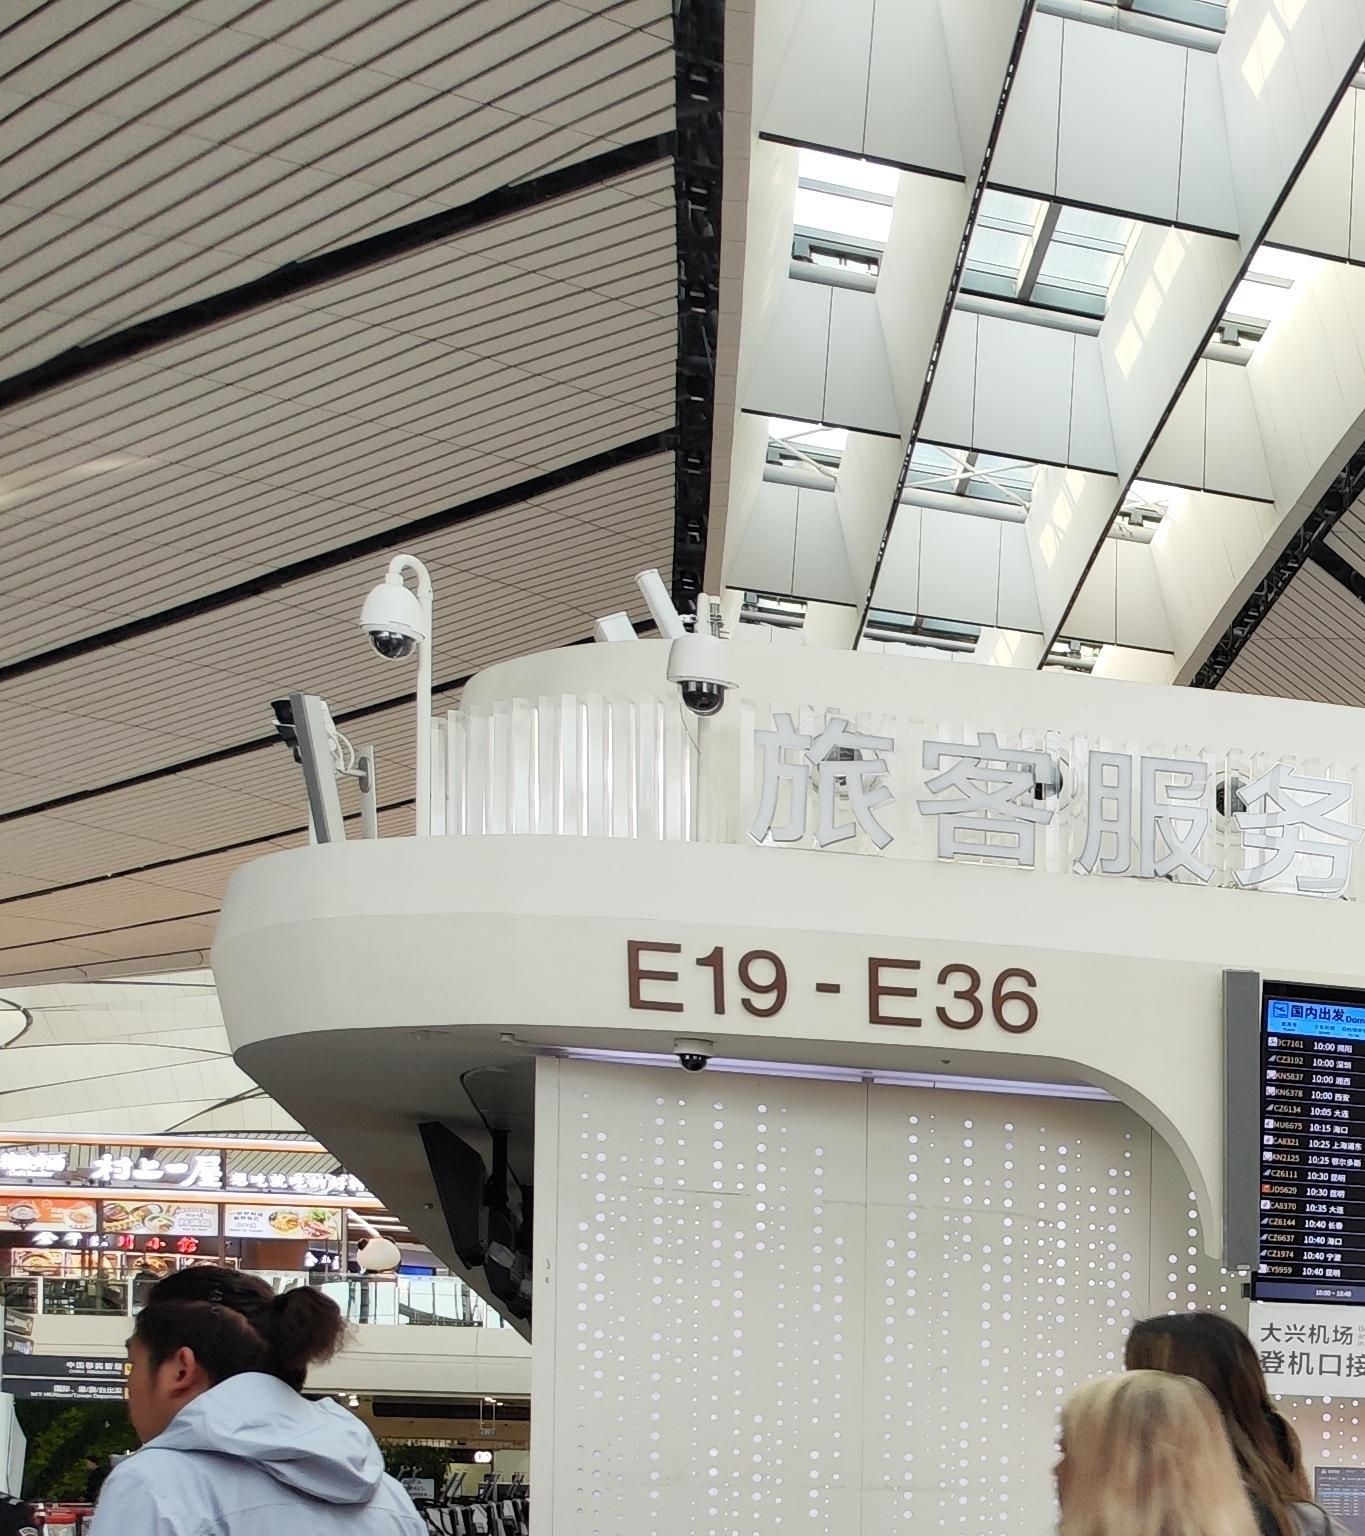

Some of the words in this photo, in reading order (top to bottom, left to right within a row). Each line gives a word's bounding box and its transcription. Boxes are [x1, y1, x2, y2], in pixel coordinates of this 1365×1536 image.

[1291, 1005, 1345, 1022] 国内出发
[1313, 1058, 1334, 1068] 10:00
[1310, 1107, 1332, 1117] 10:05
[1310, 1124, 1331, 1133] 10:15
[1308, 1156, 1329, 1165] 10:25
[91, 1153, 224, 1187] 村上一屋
[1307, 1172, 1328, 1180] 10:30
[1261, 1322, 1353, 1346] 大兴机场
